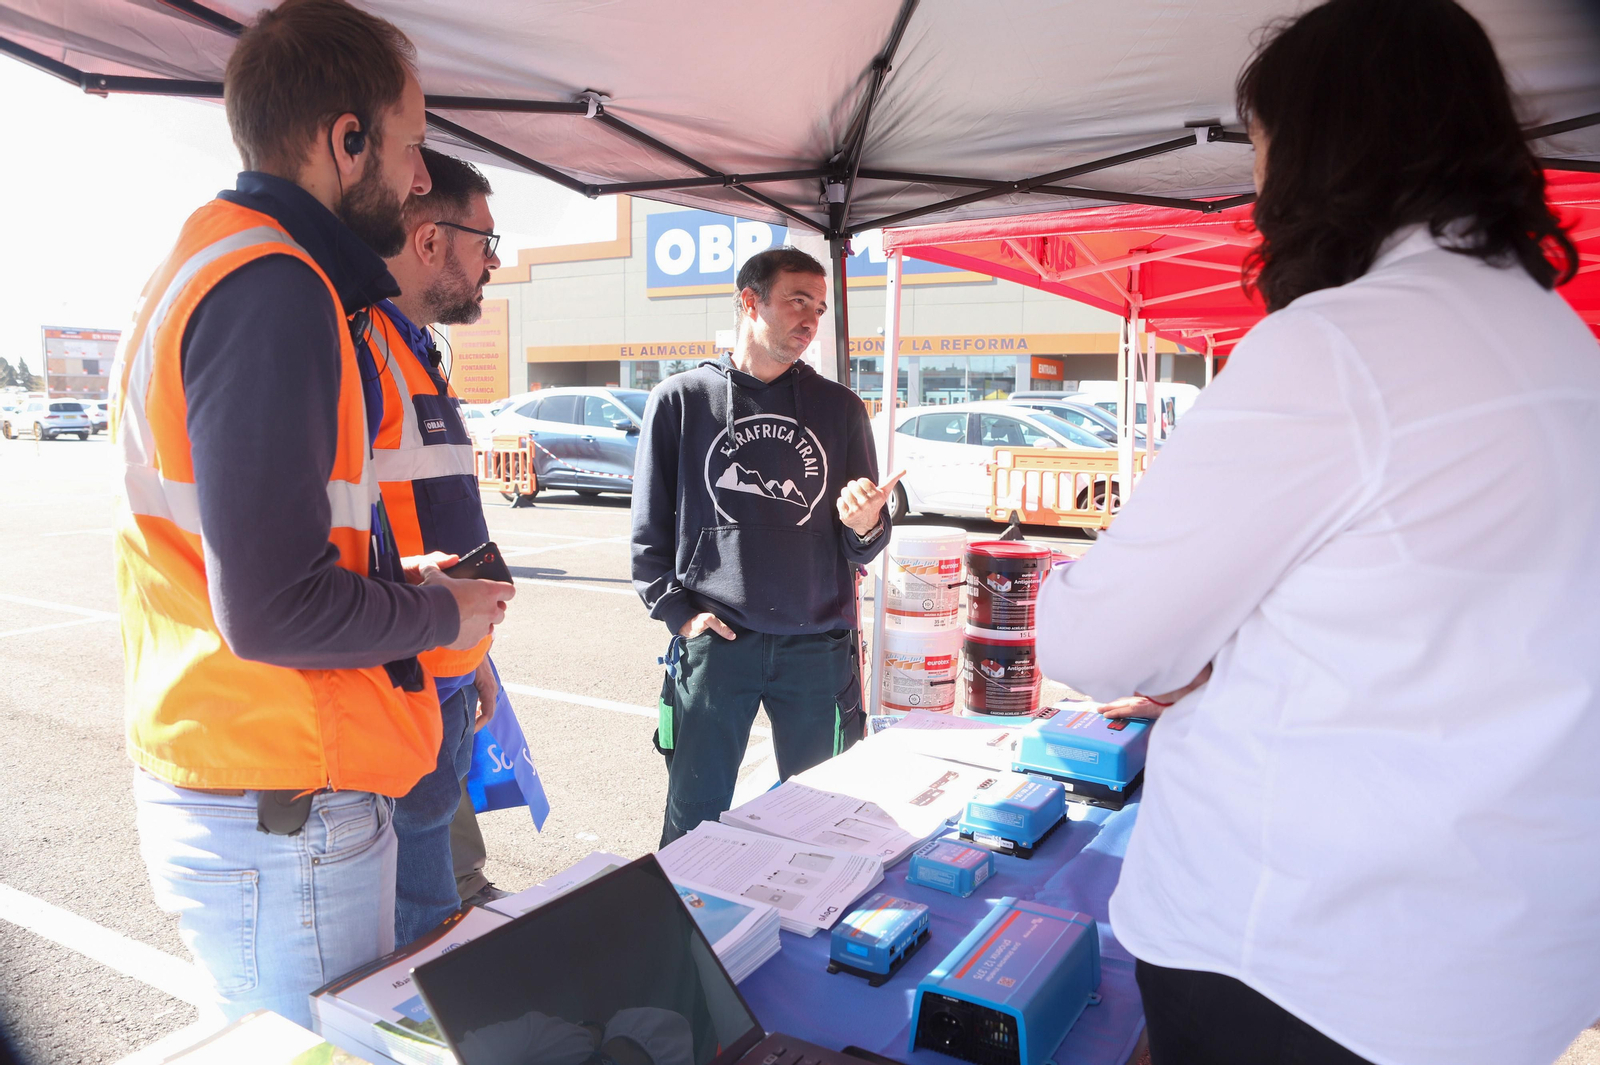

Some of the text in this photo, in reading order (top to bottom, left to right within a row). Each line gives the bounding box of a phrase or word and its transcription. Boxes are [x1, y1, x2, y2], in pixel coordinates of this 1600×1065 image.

[620, 347, 634, 356] EL
[640, 343, 706, 356] ALMACÉN
[912, 339, 933, 350] LA
[940, 338, 1028, 350] REFORMA
[461, 363, 496, 371] FONTANERÍA
[794, 437, 819, 478] TRAIL
[819, 906, 838, 921] Deye
